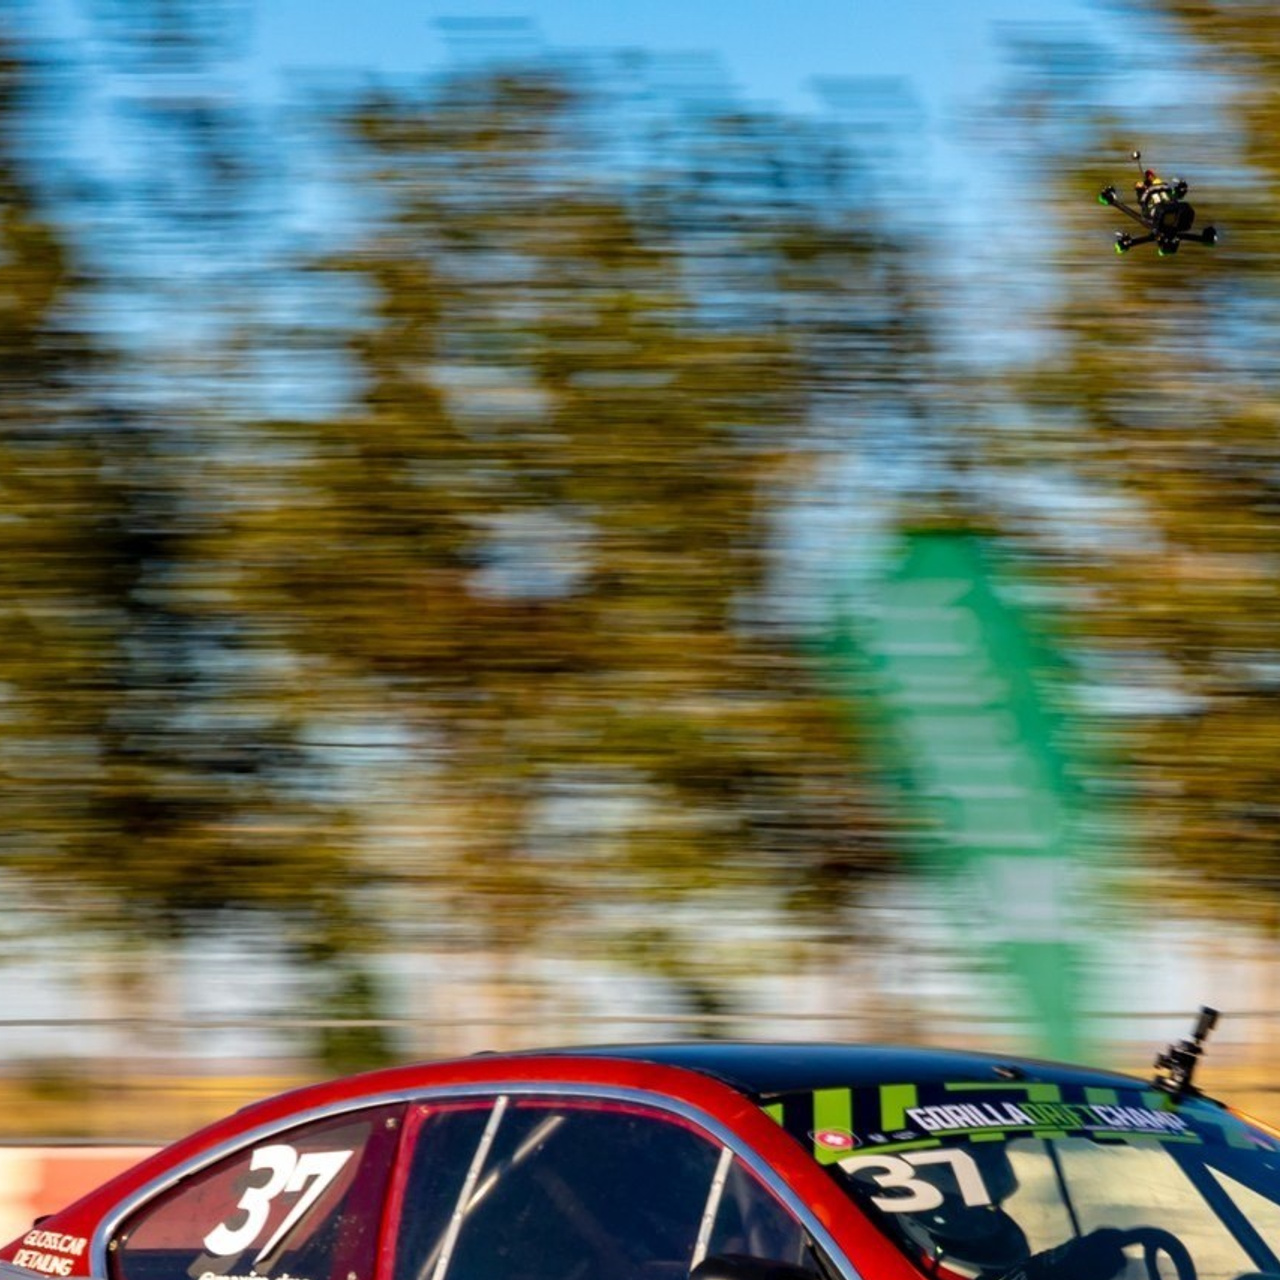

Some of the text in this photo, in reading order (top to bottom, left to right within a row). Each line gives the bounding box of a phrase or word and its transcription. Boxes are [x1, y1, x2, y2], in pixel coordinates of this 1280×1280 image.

[905, 1101, 1037, 1131] GORILLA
[203, 1144, 354, 1264] 37
[836, 1147, 992, 1212] 37
